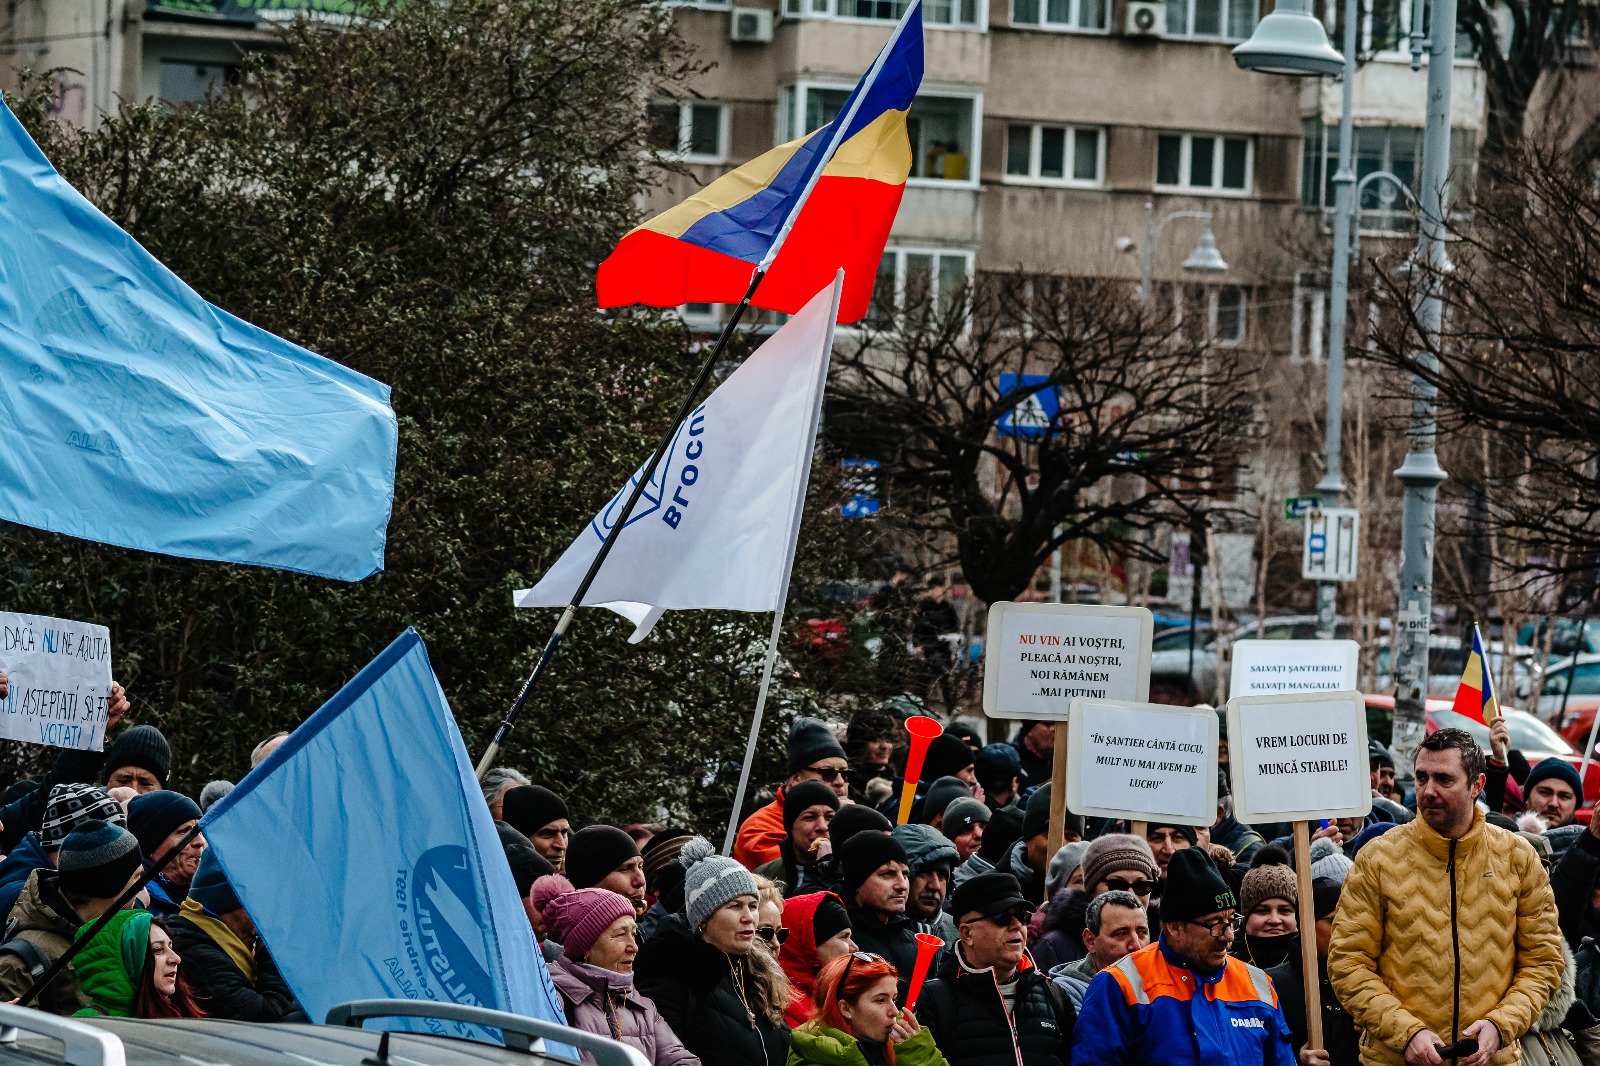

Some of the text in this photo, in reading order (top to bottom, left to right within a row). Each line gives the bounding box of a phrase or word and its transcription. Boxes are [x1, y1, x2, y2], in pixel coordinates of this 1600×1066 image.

[5, 622, 35, 652] DACĂ
[42, 628, 60, 654] NU
[61, 631, 75, 656] NE
[1020, 634, 1037, 645] NU
[1040, 635, 1060, 646] VIN
[1063, 636, 1076, 647] AI
[1020, 652, 1061, 663] PLEACĂ
[1064, 654, 1076, 664] AI
[1030, 669, 1109, 682] NOI RĂMÂNEM
[1288, 682, 1340, 690] MANGALIA!
[1146, 739, 1176, 751] CÂNTĂ
[1178, 743, 1204, 755] CUCU,
[1256, 733, 1348, 749] VREM LOCURI DE
[1096, 756, 1198, 774] MULT NU MAI AVEM DE
[1258, 759, 1348, 775] MUNCĂ STABILE!
